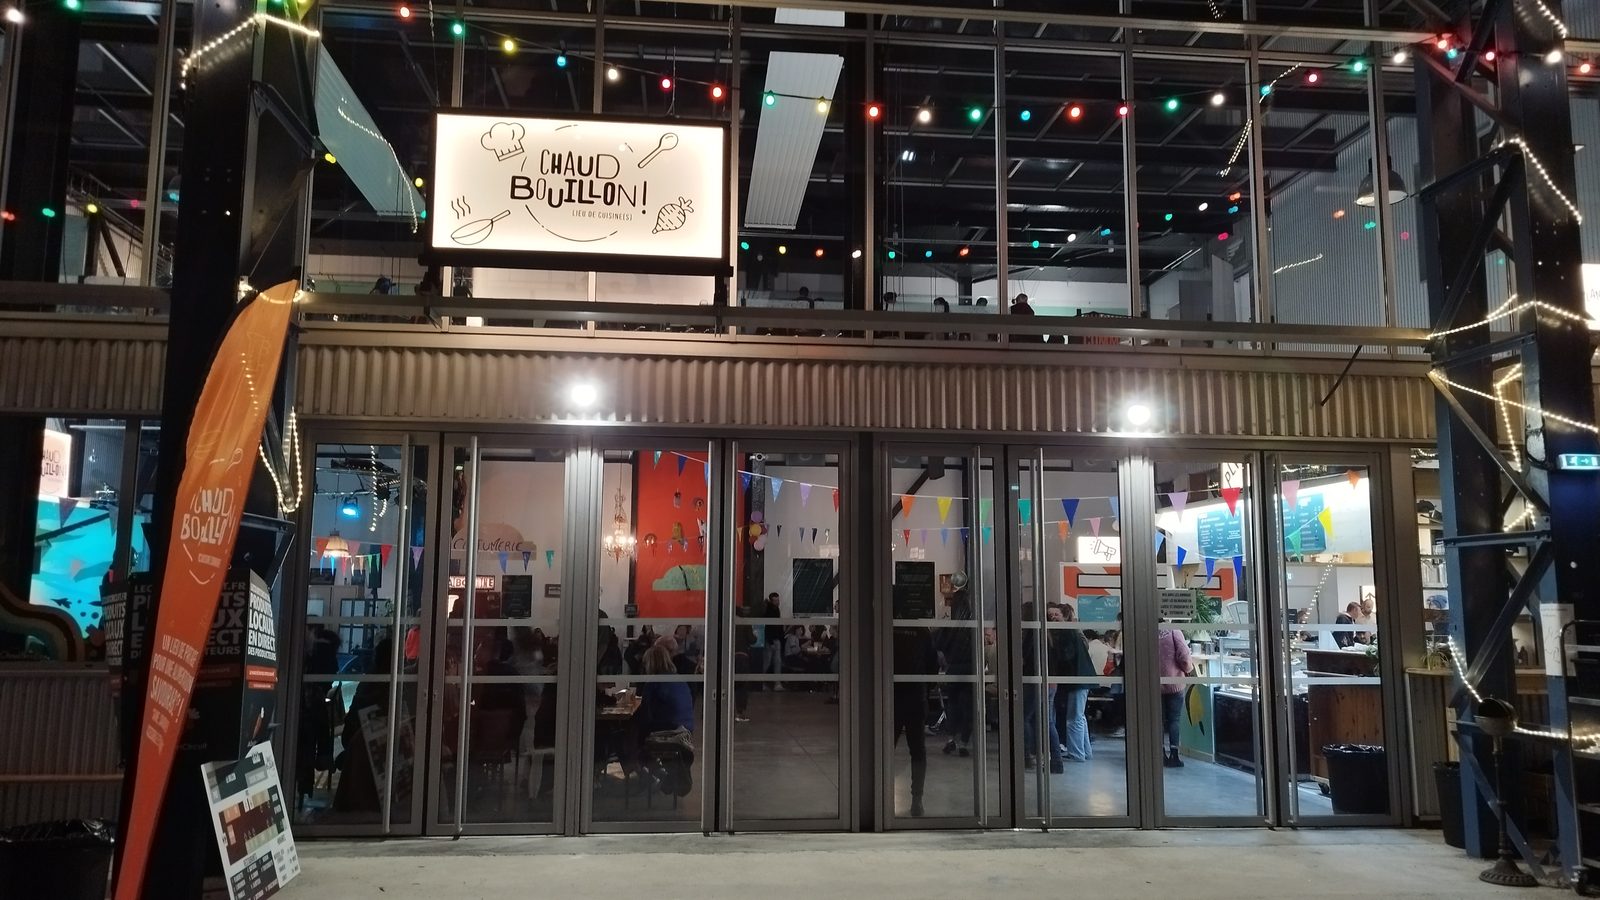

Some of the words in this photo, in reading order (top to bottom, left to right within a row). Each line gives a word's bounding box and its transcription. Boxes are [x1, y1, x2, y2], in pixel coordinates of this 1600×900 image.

[540, 149, 620, 180] CHAUD
[509, 175, 648, 215] BOUILLON!
[572, 210, 586, 218] LIEU
[588, 211, 597, 219] DE
[249, 609, 275, 637] LOCAUX
[248, 629, 257, 646] EN
[257, 632, 276, 652] DIRECT
